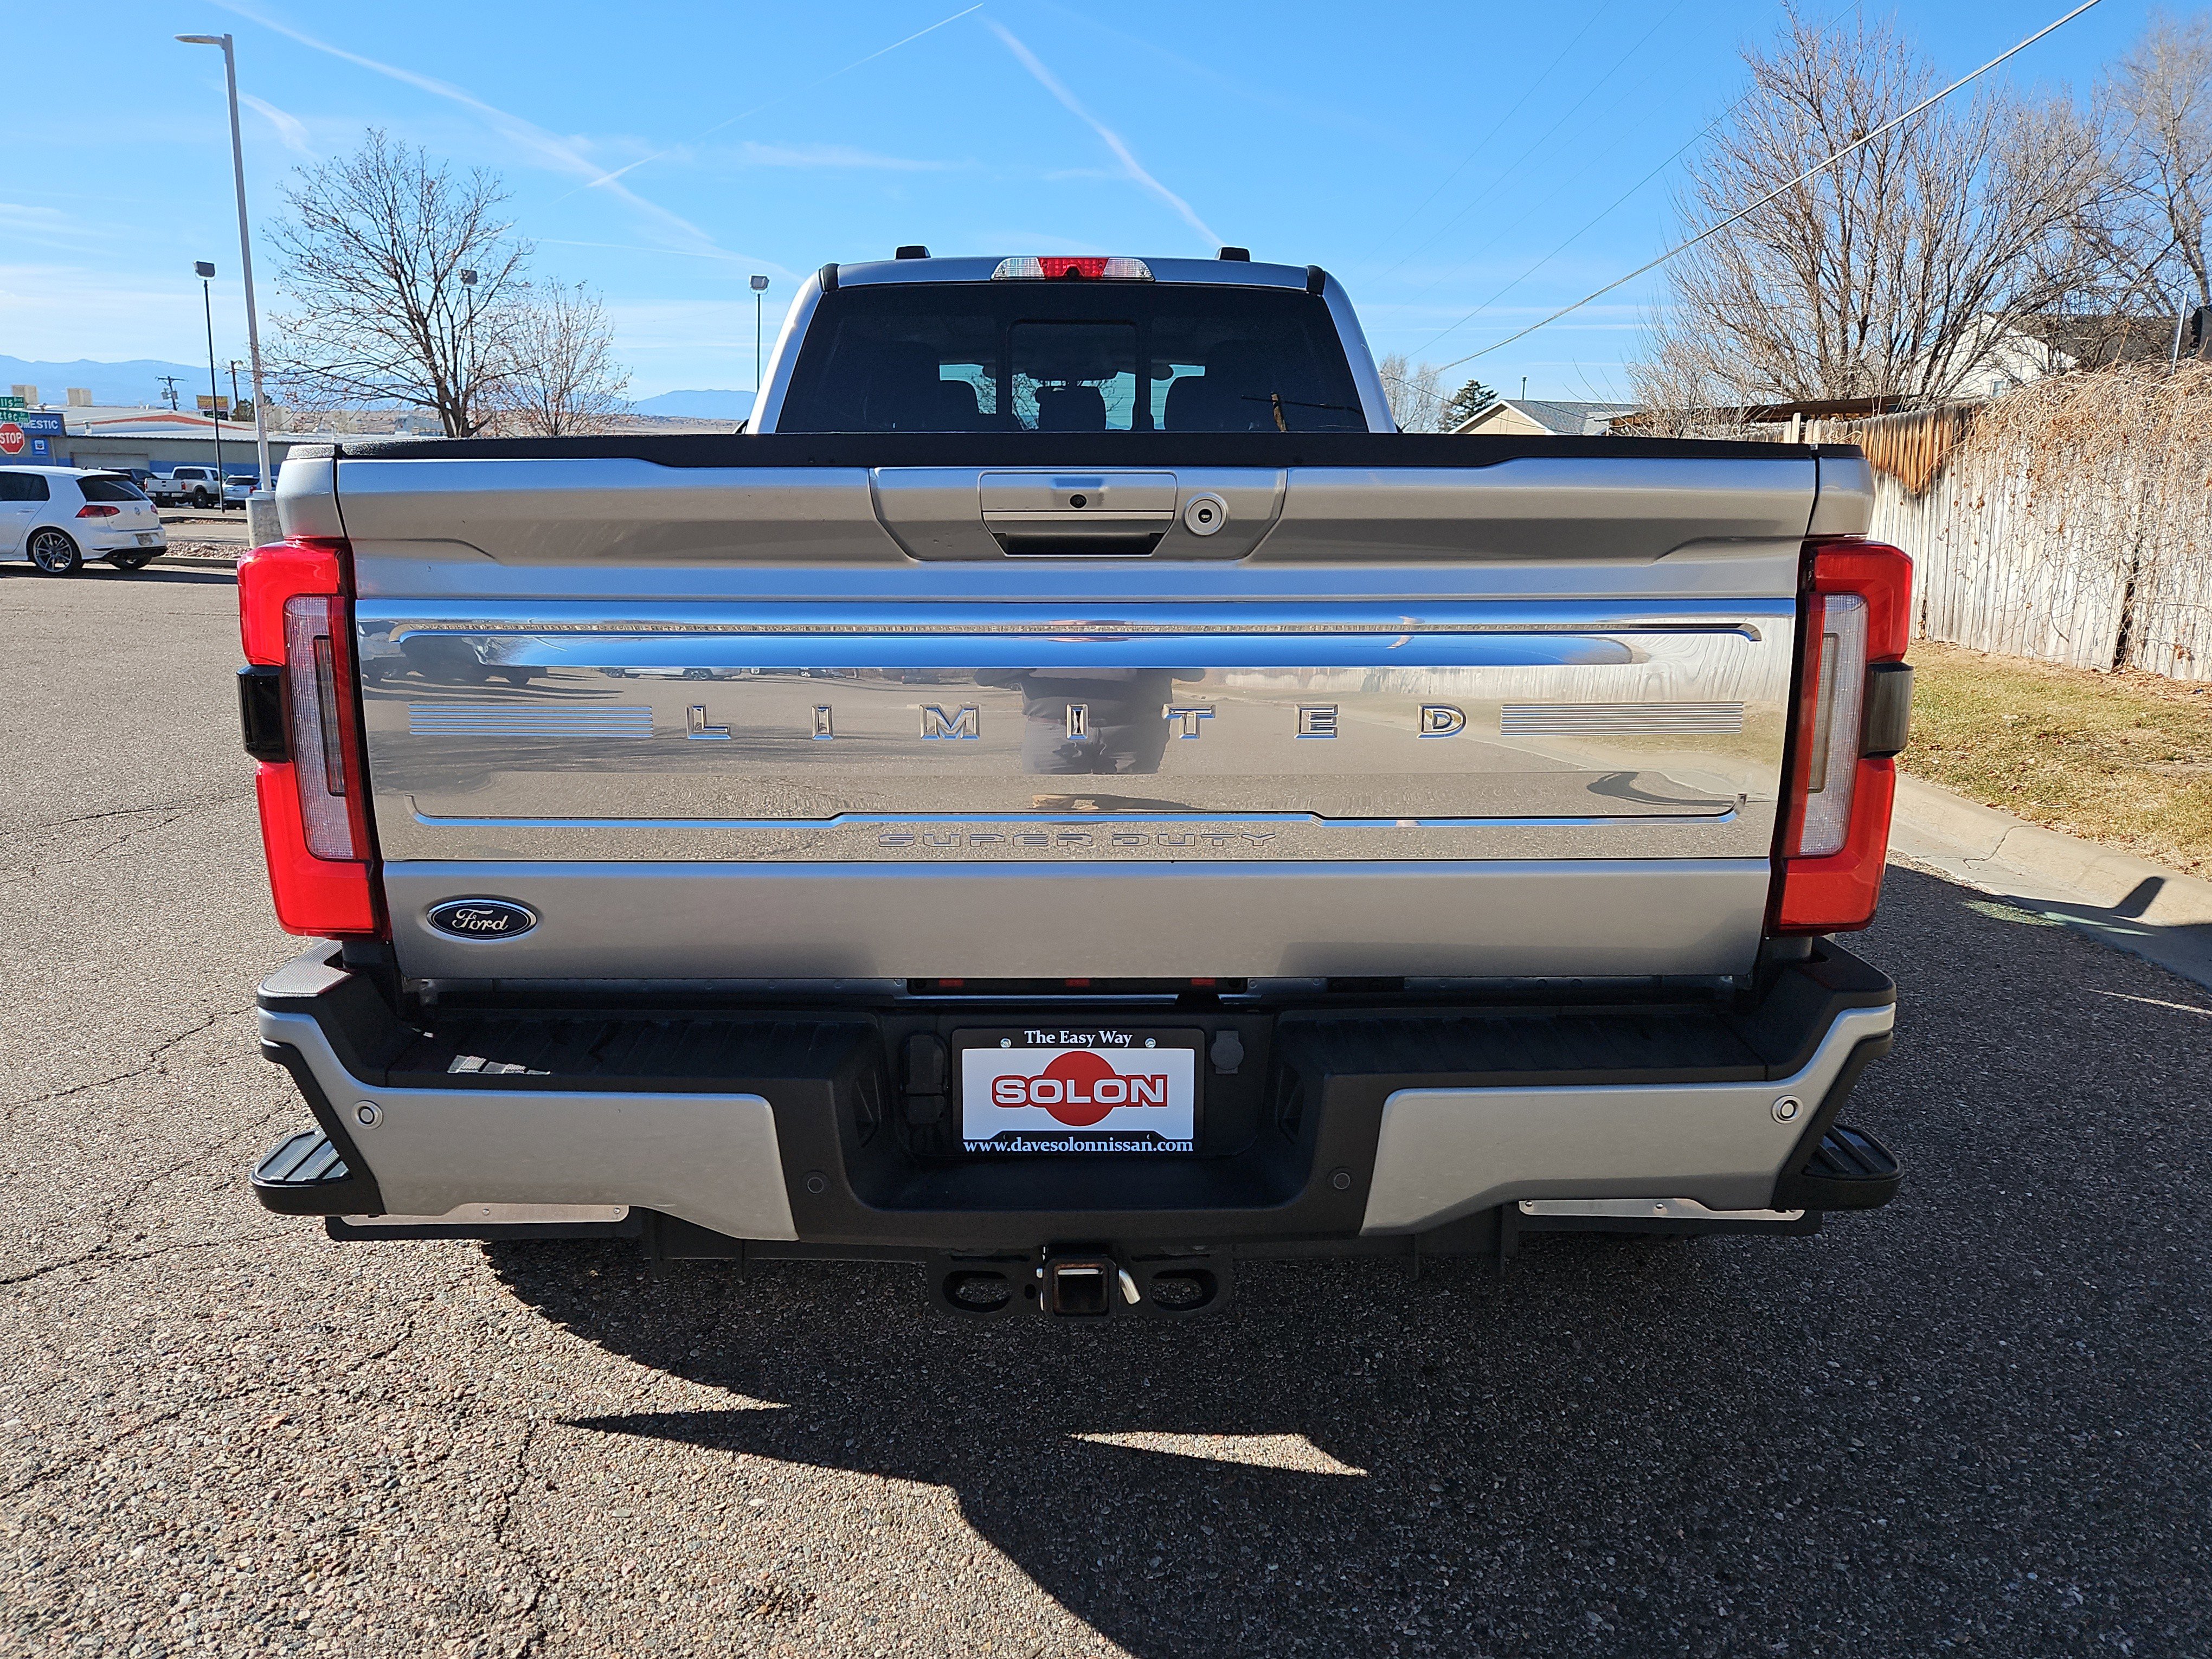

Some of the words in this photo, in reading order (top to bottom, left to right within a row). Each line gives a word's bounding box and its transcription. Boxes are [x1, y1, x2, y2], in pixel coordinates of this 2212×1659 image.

[17, 420, 58, 429] OMESTIC
[0, 432, 22, 444] STOP
[686, 703, 1467, 740] LIMITED
[878, 833, 1092, 847] SUPER
[1111, 833, 1277, 847] DUTY
[452, 908, 509, 931] Ford
[1024, 1030, 1056, 1044] The
[1059, 1031, 1095, 1047] Easy
[1098, 1031, 1133, 1047] Way
[994, 1078, 1165, 1104] SOLON
[963, 1136, 1194, 1153] www.davesolonnissan.com
